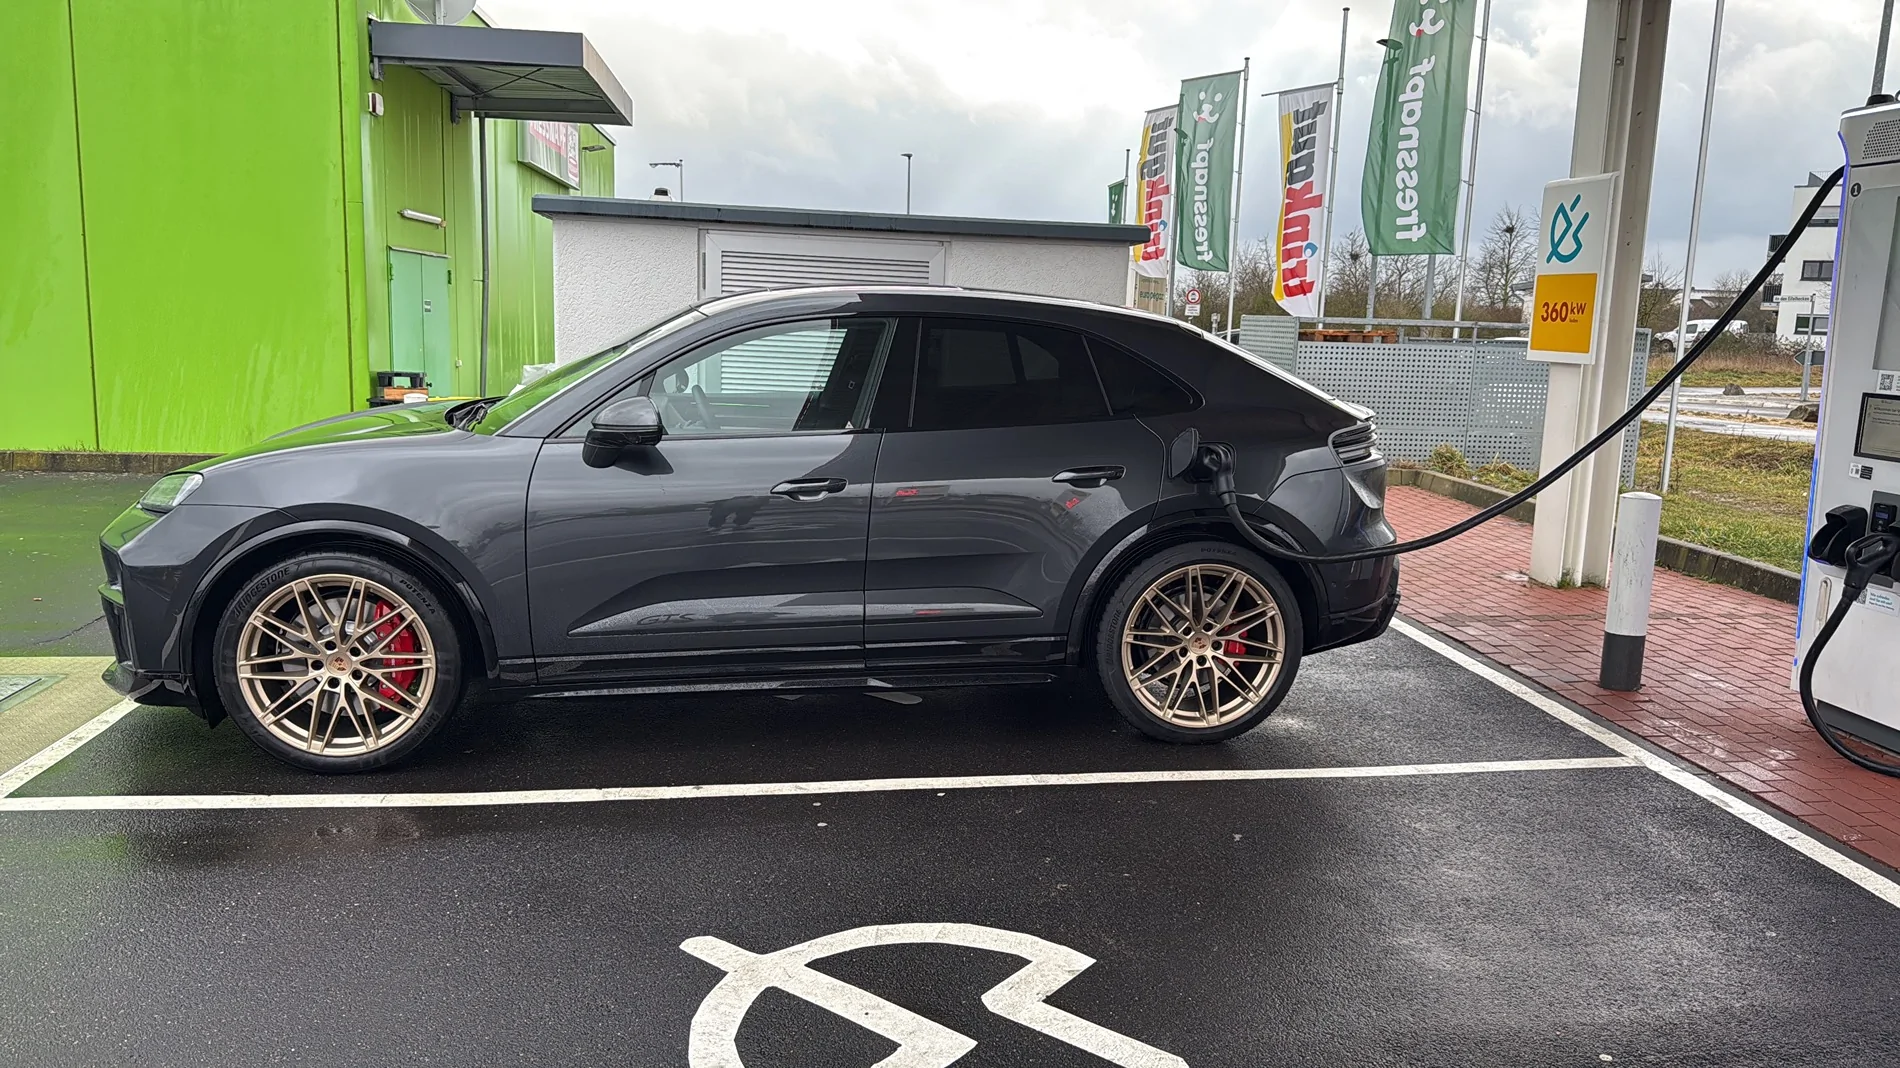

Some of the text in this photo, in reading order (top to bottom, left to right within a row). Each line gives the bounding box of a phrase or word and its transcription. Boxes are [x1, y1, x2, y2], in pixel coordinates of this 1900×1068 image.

[1541, 301, 1588, 323] 360 kW
[399, 579, 436, 615] POTENZA
[636, 613, 696, 625] GTS
